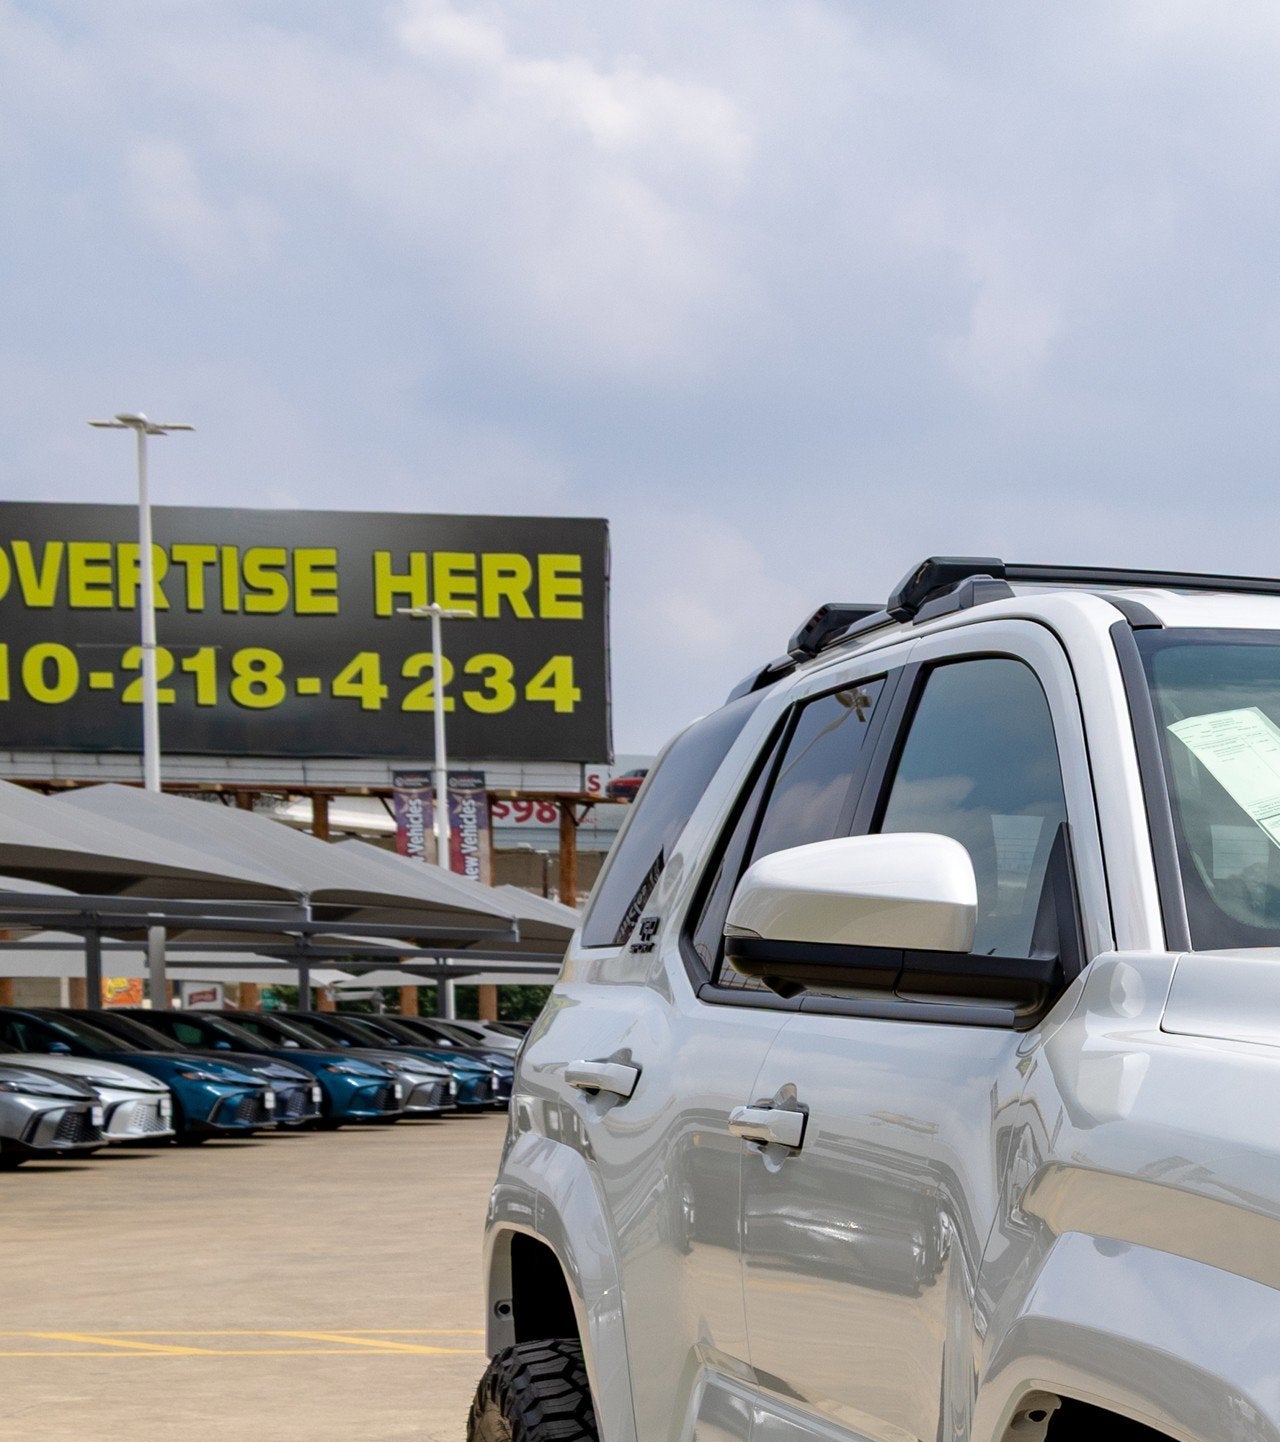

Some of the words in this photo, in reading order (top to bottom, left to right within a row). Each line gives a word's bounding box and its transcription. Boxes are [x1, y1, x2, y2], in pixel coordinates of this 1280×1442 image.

[0, 540, 339, 614] VERTISE
[374, 550, 583, 620] HERE
[0, 642, 582, 714] 0-218-4234
